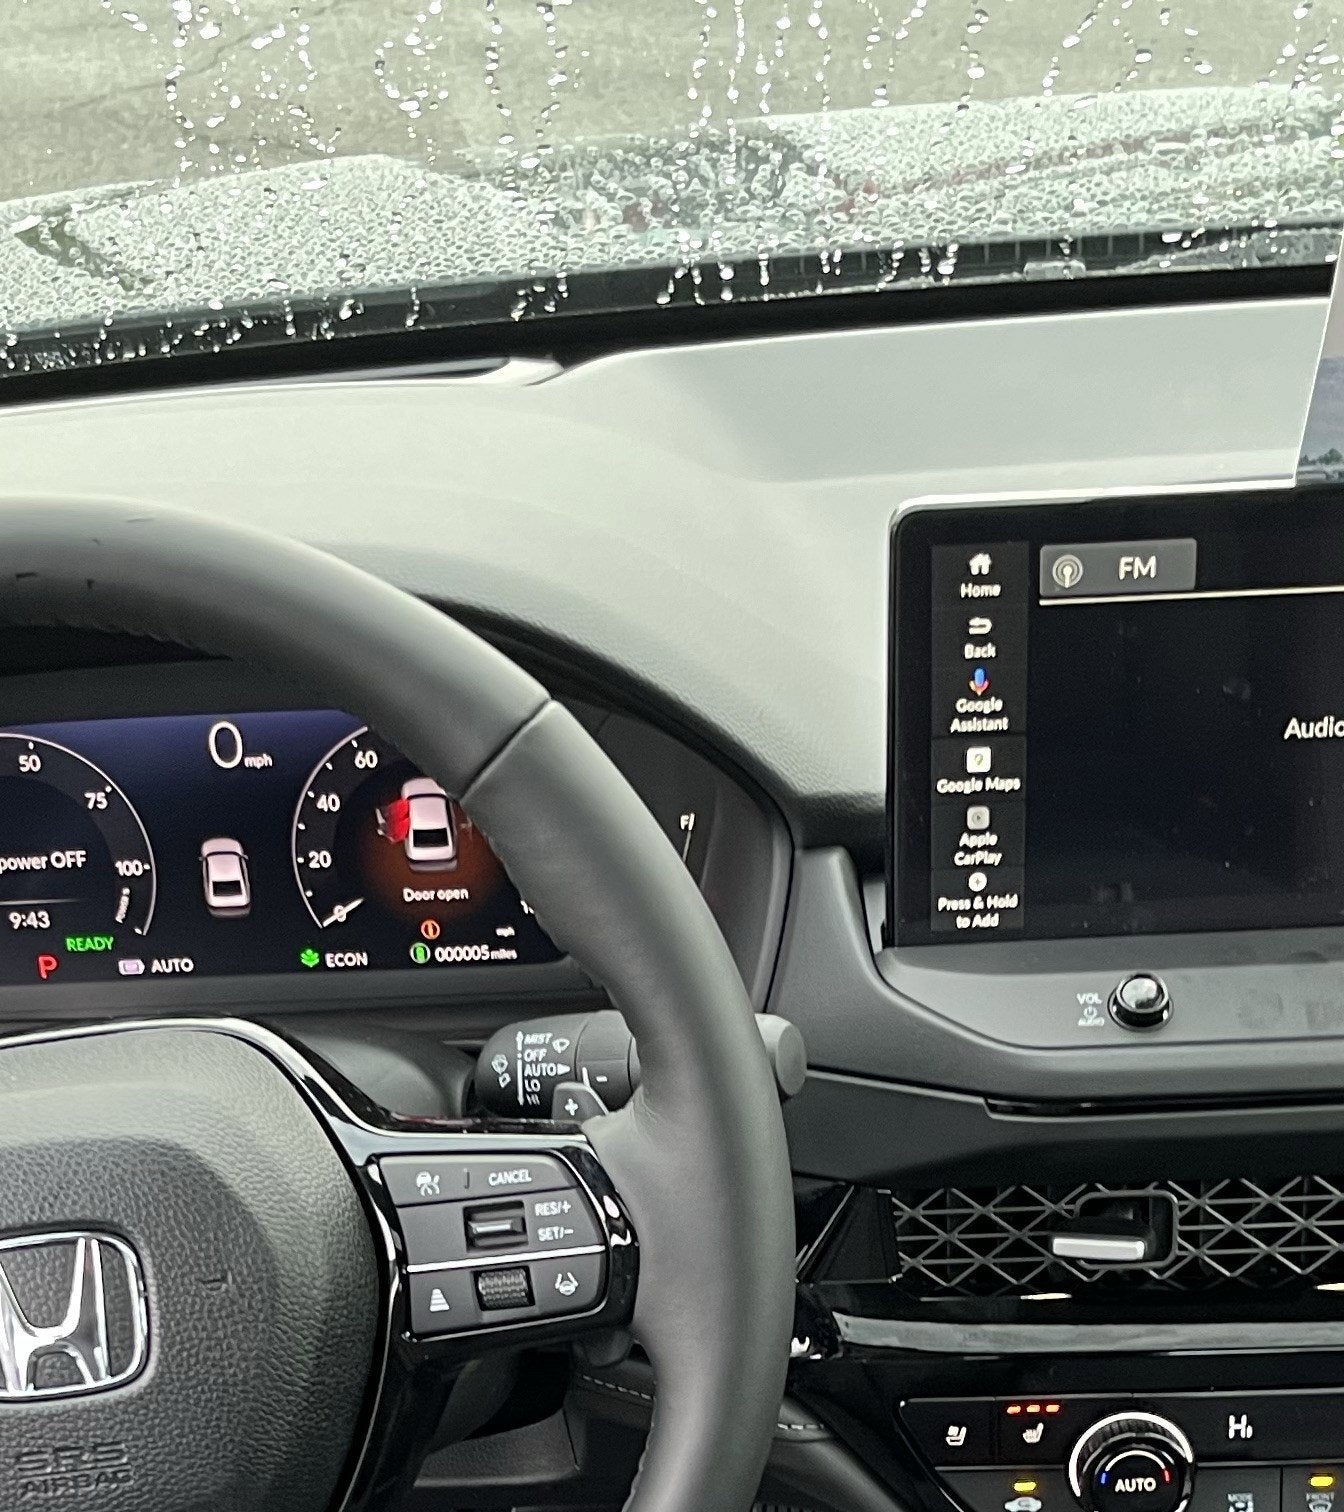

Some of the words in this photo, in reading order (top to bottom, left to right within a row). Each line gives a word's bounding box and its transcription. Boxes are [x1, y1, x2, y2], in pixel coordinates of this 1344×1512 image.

[1118, 556, 1157, 580] FM
[960, 583, 1001, 598] Home
[964, 643, 996, 659] Back
[956, 697, 1003, 714] Google
[950, 717, 1009, 733] Assistant
[209, 721, 243, 769] 0
[244, 753, 273, 769] mph
[19, 754, 41, 773] 50
[354, 750, 378, 769] 60
[936, 777, 983, 794] Google
[985, 776, 1021, 792] Maps
[85, 791, 108, 810] 75
[316, 794, 340, 812] 40
[959, 831, 998, 849] Apple
[50, 850, 87, 869] OFF
[308, 850, 332, 868] 20
[954, 851, 1002, 867] CarPlay
[115, 859, 144, 877] 100
[403, 887, 435, 902] Door
[437, 888, 469, 902] open
[938, 896, 971, 912] Press
[972, 895, 984, 910] &
[986, 893, 1019, 909] Hold
[8, 910, 51, 930] 9:43
[956, 915, 971, 929] to
[972, 912, 1000, 928] Add
[66, 936, 114, 952] READY
[325, 952, 368, 968] ECON
[435, 945, 489, 962] 000005
[490, 948, 517, 961] miles
[37, 954, 58, 980] P
[150, 958, 194, 974] AUTO
[1076, 992, 1103, 1005] VOL
[523, 1048, 548, 1062] OFF
[524, 1062, 557, 1077] AUTO
[524, 1079, 541, 1093] LO
[488, 1168, 533, 1186] CANCEL
[1114, 1477, 1157, 1493] AUTO
